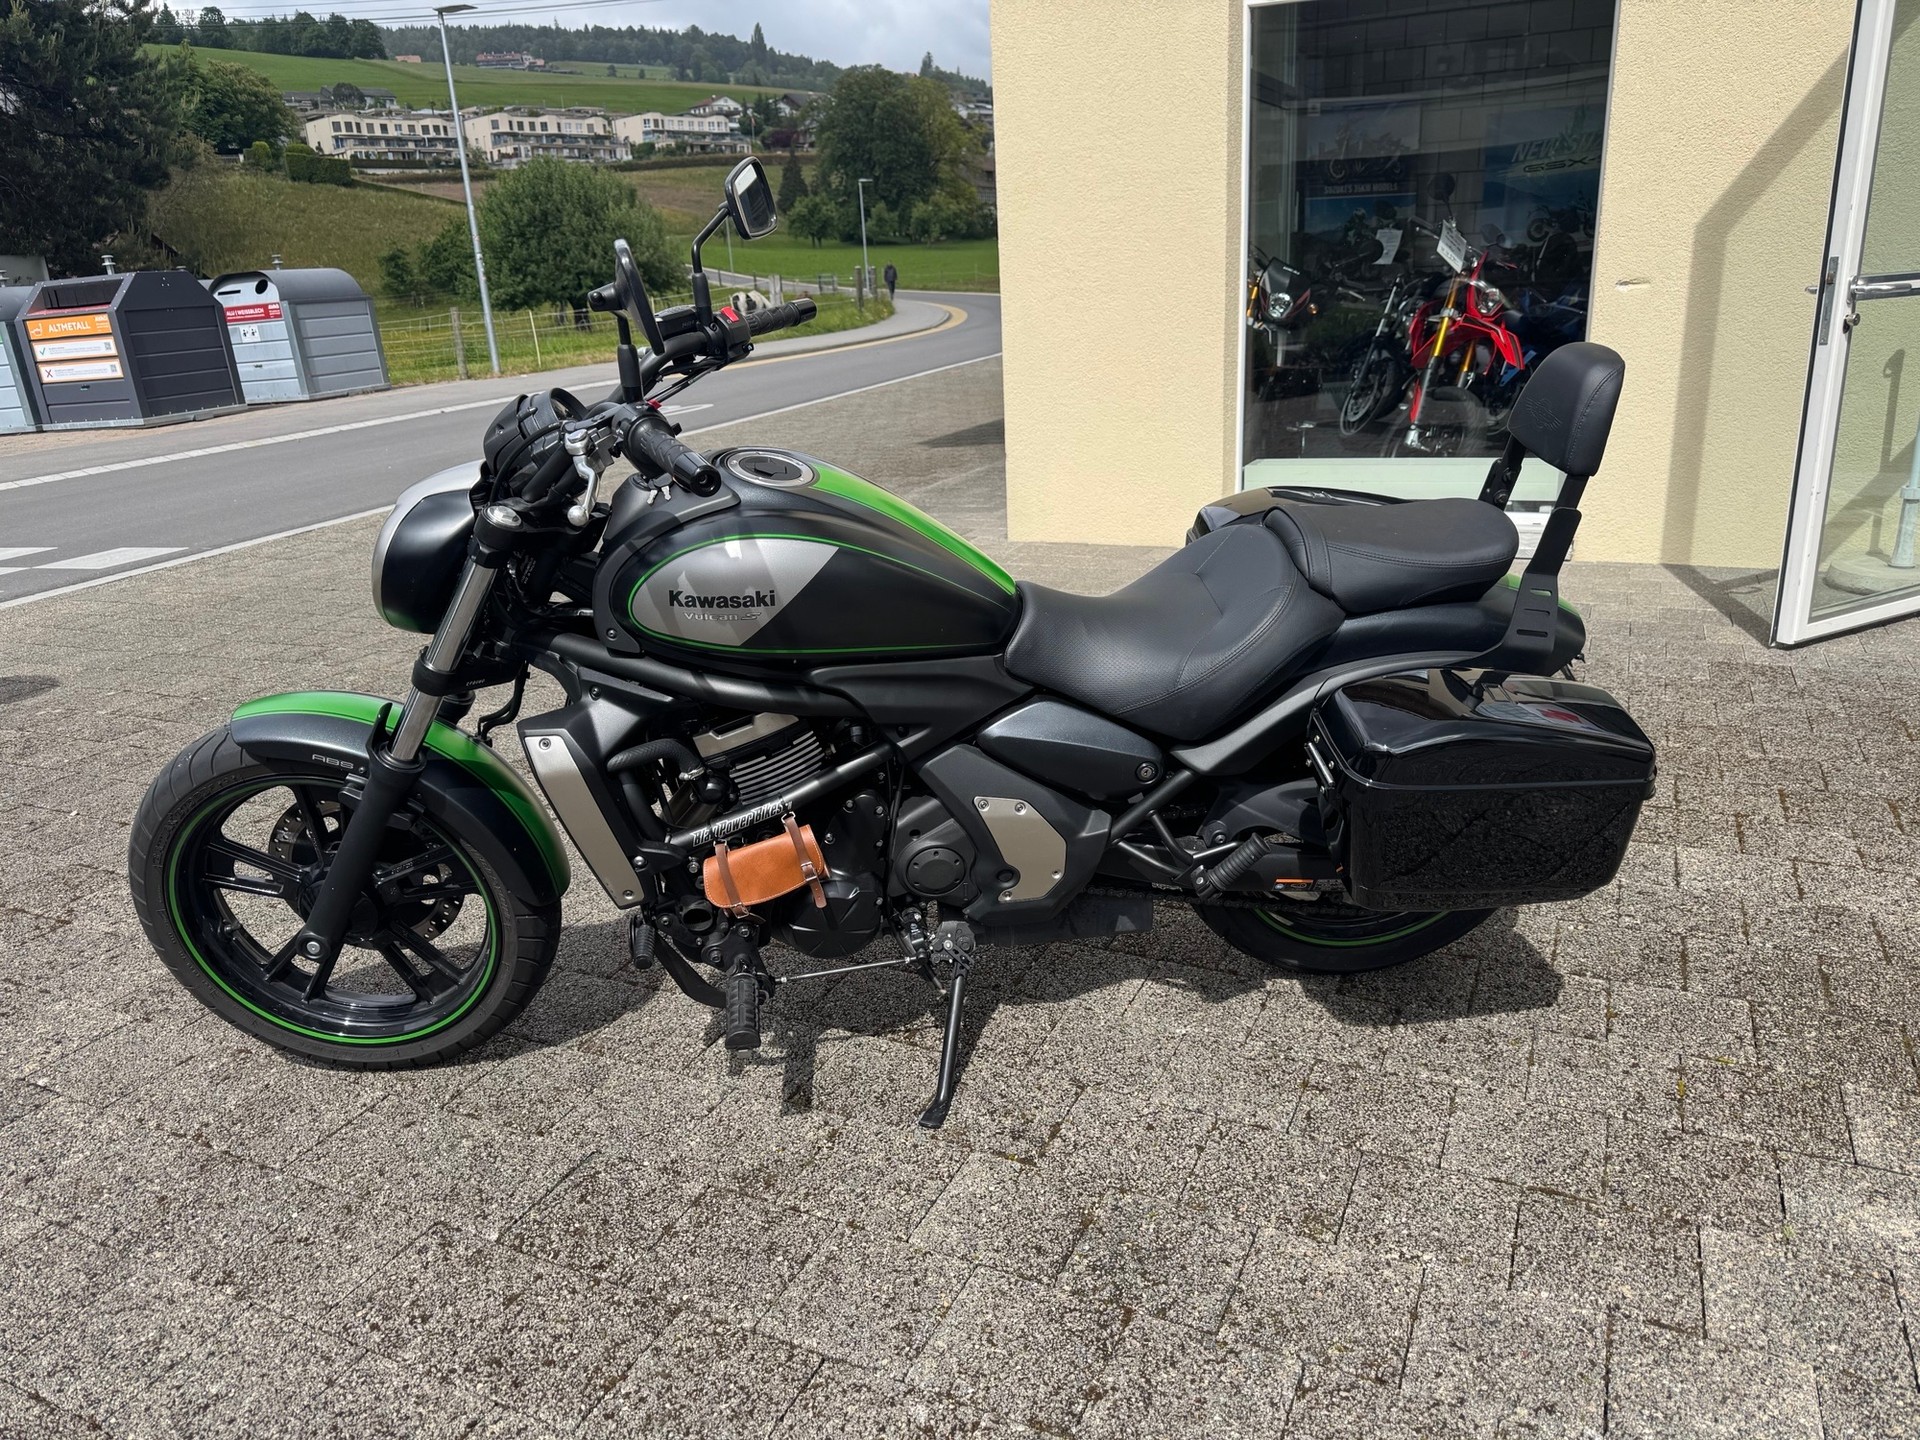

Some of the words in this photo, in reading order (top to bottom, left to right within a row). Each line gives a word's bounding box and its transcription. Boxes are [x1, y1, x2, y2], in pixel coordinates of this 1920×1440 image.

[48, 321, 91, 333] ALTMETALL
[668, 590, 776, 609] Kawasaki
[684, 611, 738, 621] Vulcan
[312, 754, 354, 770] ABS
